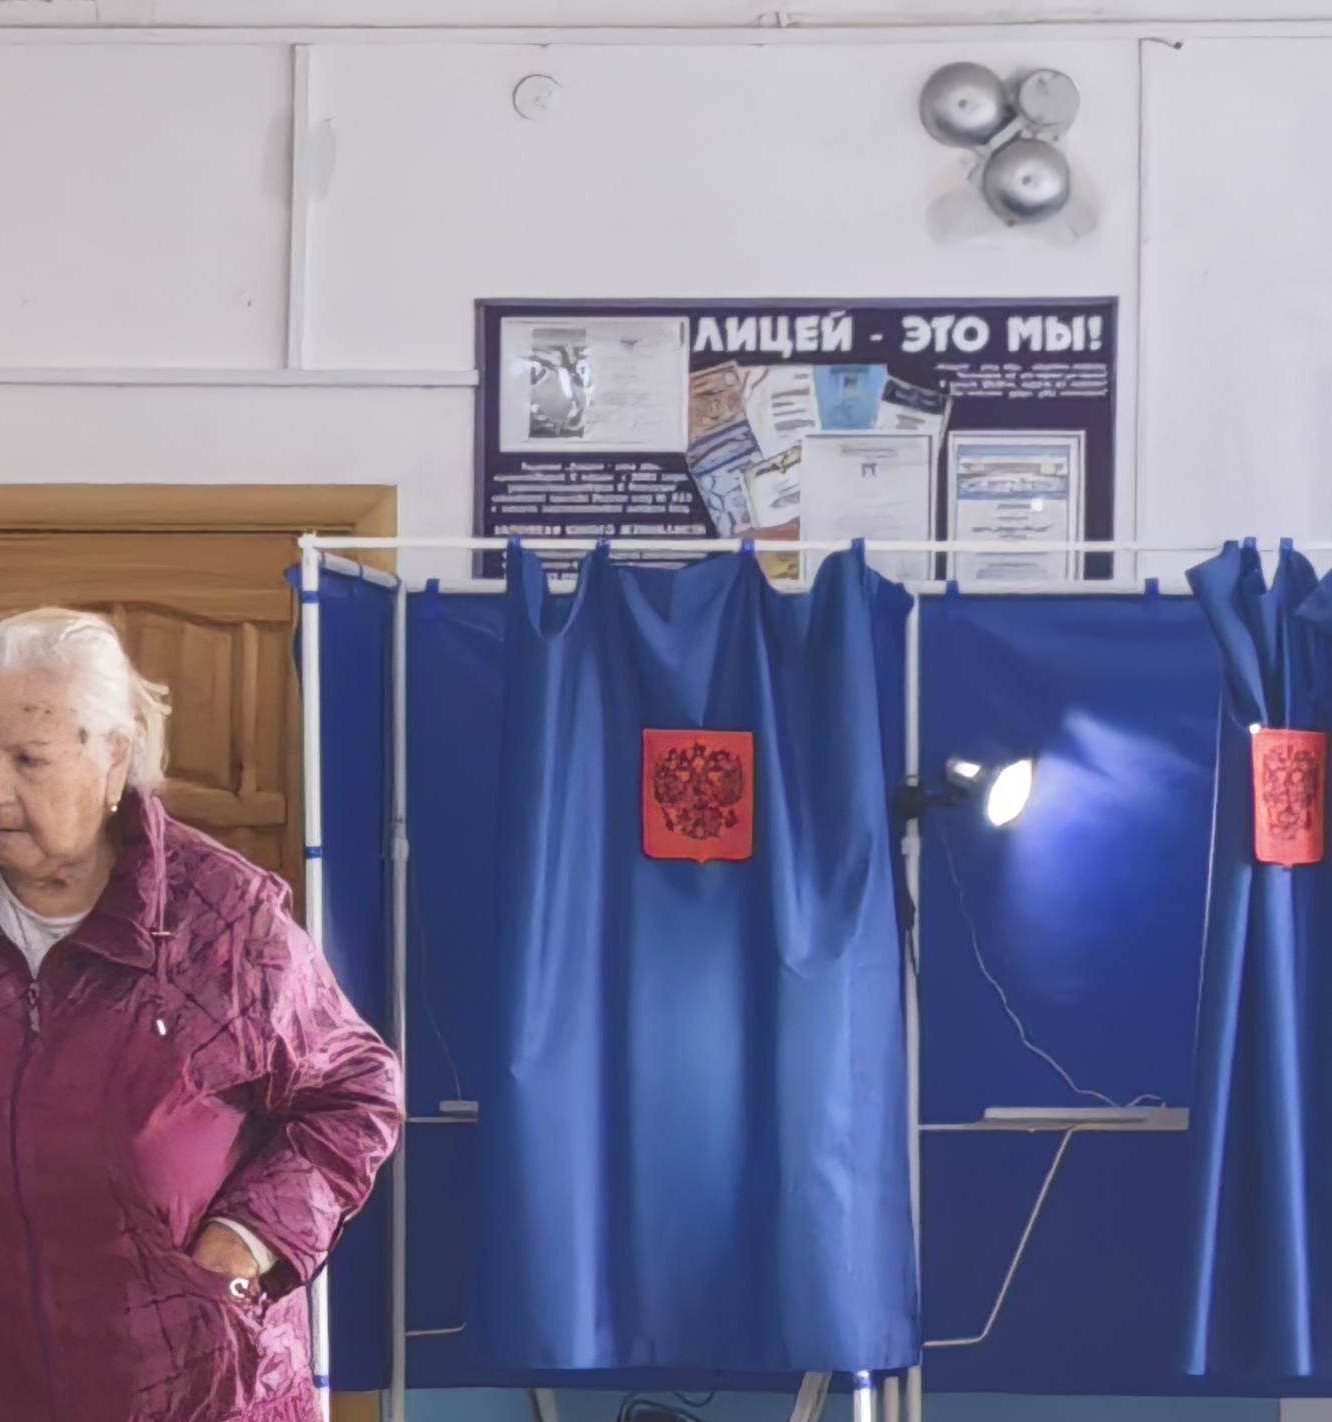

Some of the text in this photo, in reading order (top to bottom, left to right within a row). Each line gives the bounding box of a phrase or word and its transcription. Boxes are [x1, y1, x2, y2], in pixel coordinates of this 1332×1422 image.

[693, 310, 853, 359] ЛИЦЕЙ
[901, 316, 990, 353] ЭТО
[1008, 316, 1103, 353] МЫ!
